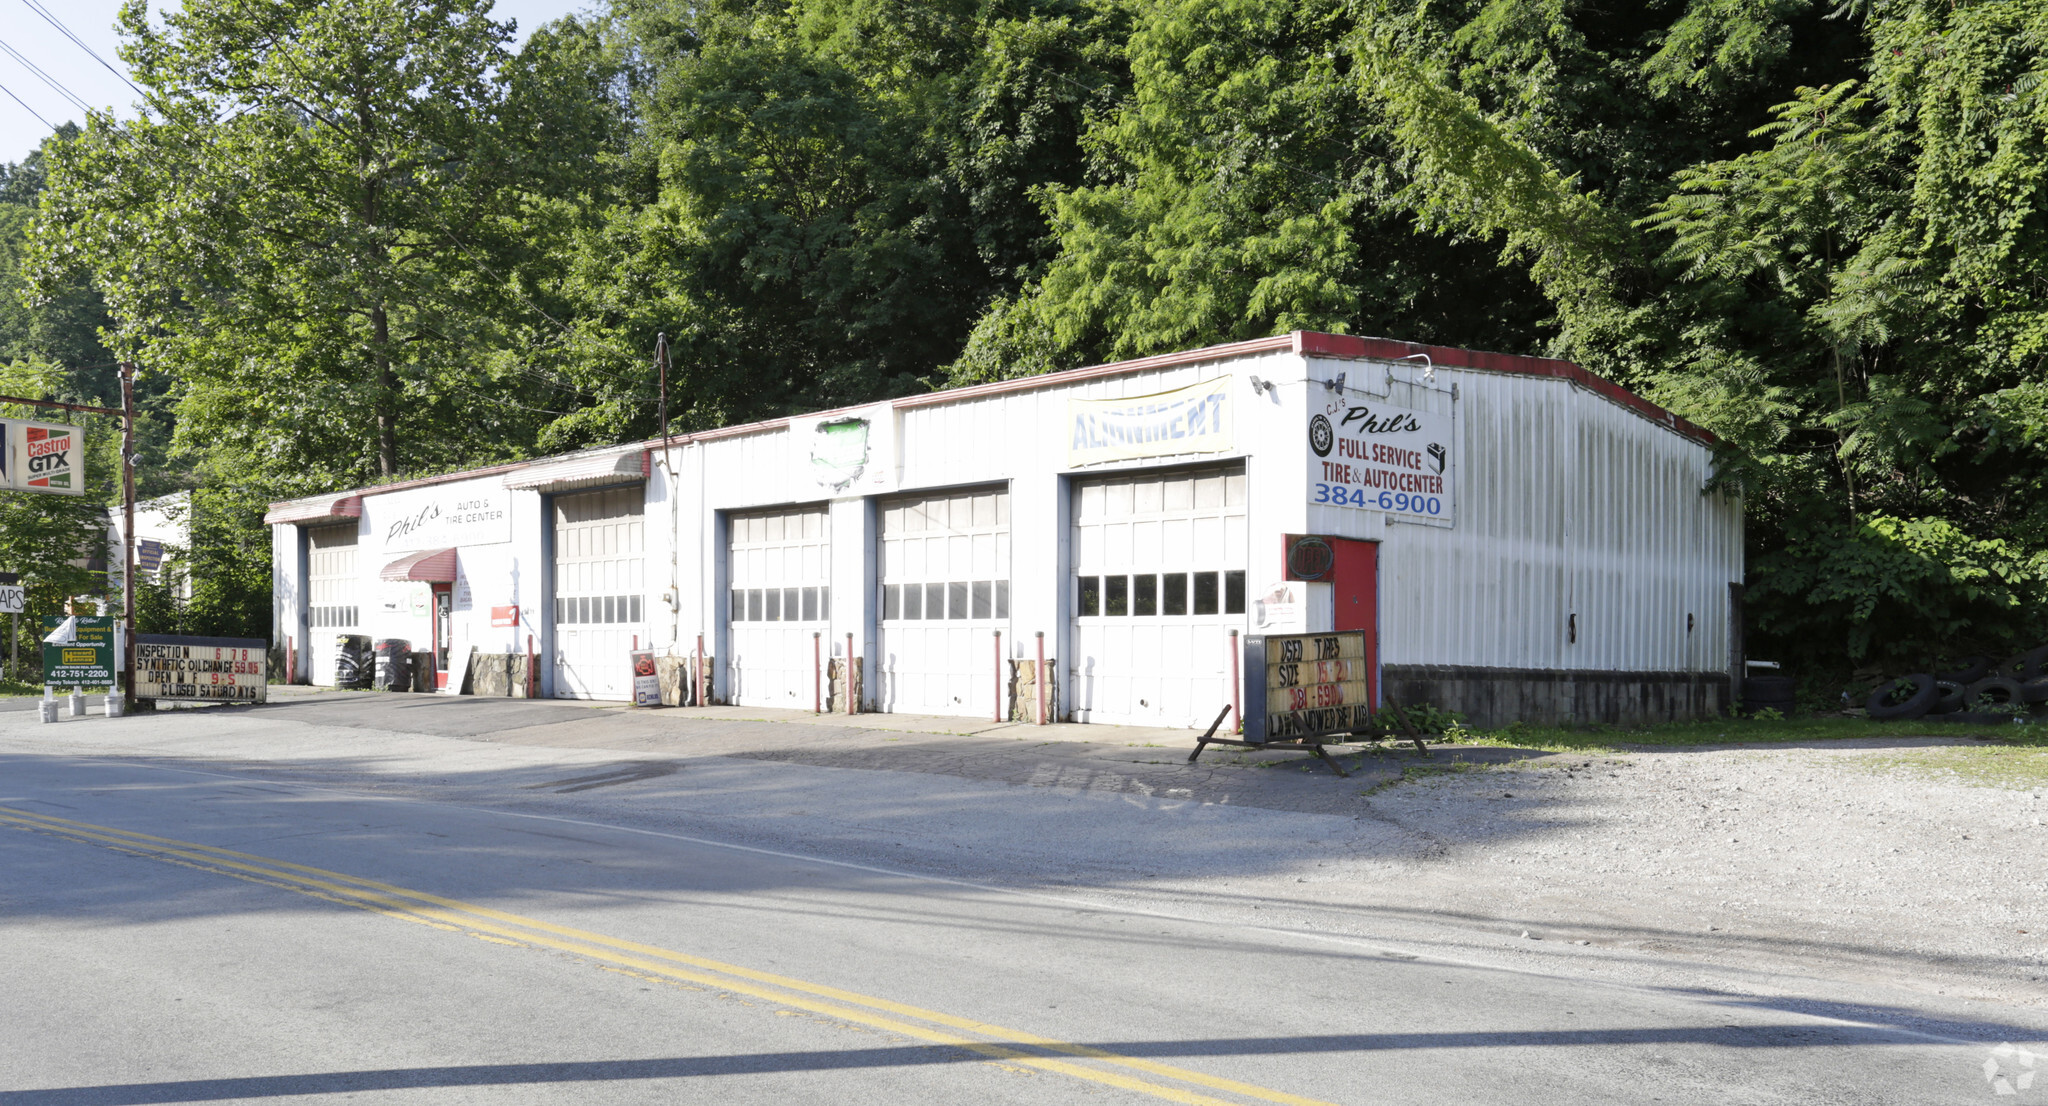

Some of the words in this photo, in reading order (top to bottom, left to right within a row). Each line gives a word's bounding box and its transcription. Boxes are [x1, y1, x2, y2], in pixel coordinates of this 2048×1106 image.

[1073, 393, 1226, 450] ALIGNMENT
[1340, 406, 1421, 434] Phil's
[28, 436, 70, 457] Castrol
[1338, 438, 1369, 460] FULL
[1372, 443, 1421, 470] SERVICE
[28, 450, 69, 473] GTX
[1322, 461, 1351, 484] TIRE
[1352, 468, 1361, 483] &
[457, 500, 481, 511] AUTO
[484, 499, 489, 508] &
[1314, 483, 1441, 515] 384-6900
[385, 501, 442, 546] Phil's
[445, 514, 463, 525] TIRE
[466, 510, 503, 523] CENTER
[216, 648, 222, 660] 6
[232, 649, 237, 661] 7
[1281, 639, 1303, 662] USED
[51, 670, 108, 678] 412-751-2200
[148, 670, 172, 684] OPEN
[1279, 664, 1299, 687] SIZE
[162, 684, 196, 697] CLOSED
[201, 685, 257, 698] SATURDAYS
